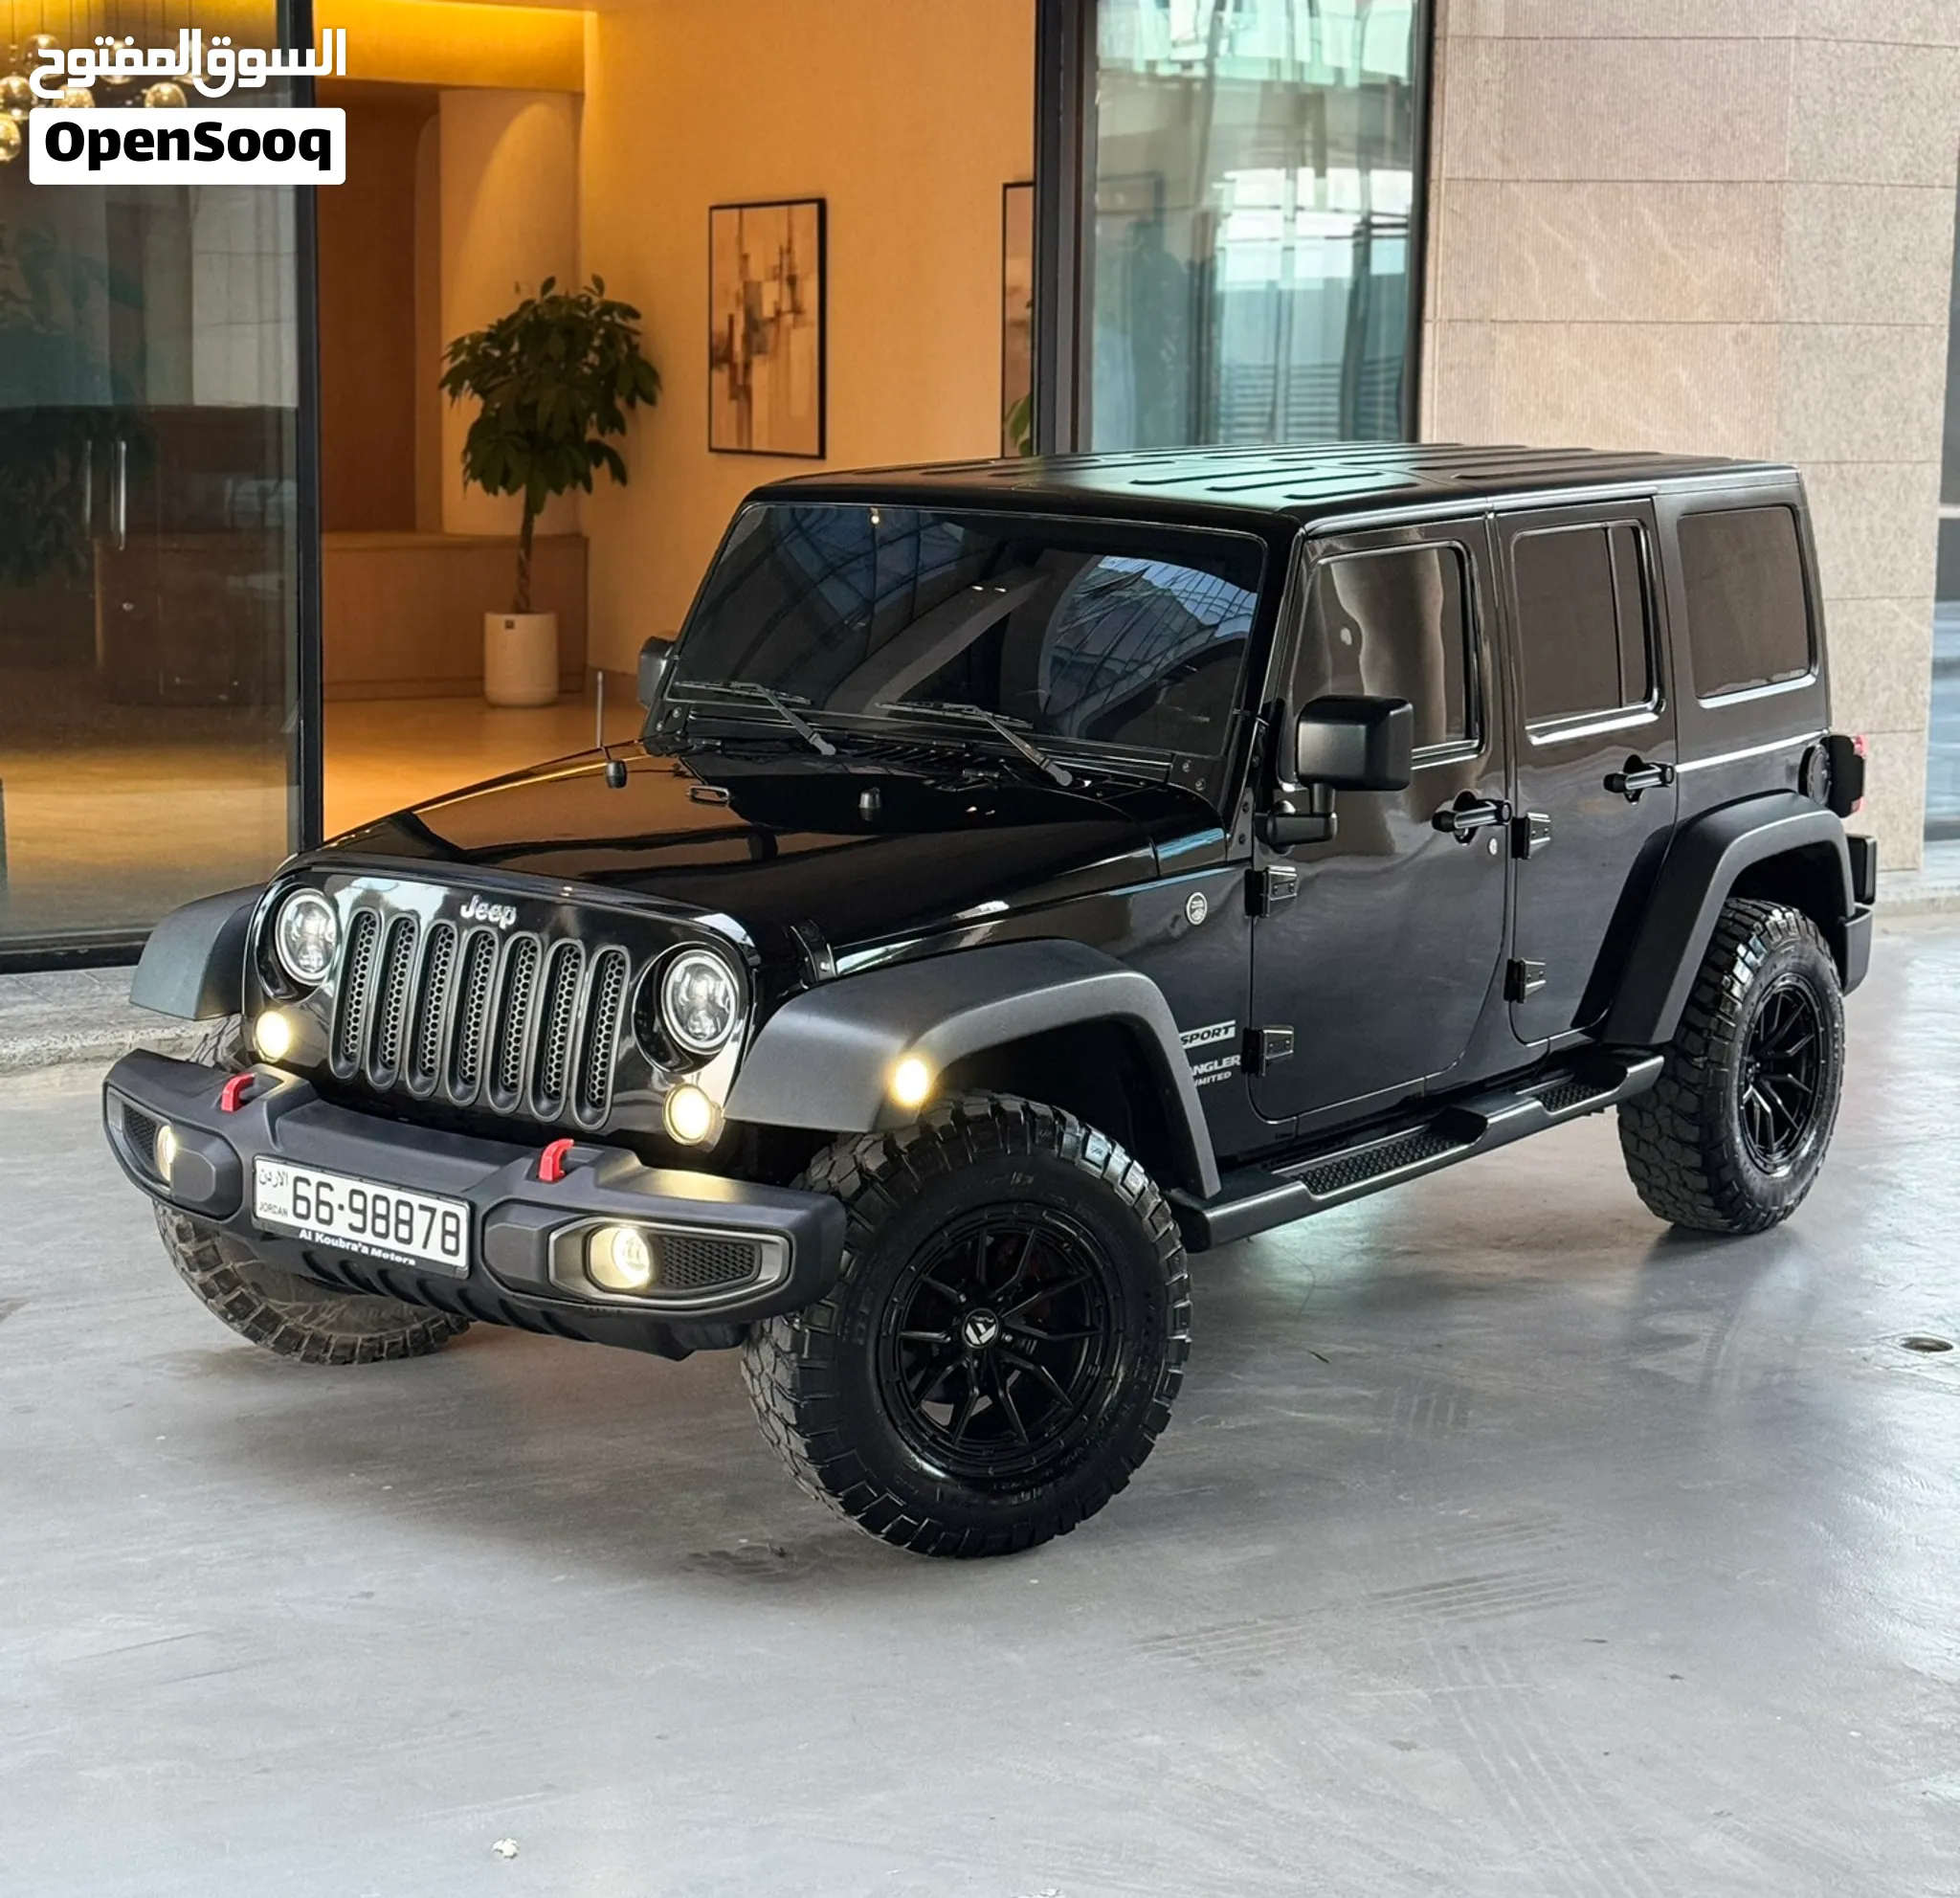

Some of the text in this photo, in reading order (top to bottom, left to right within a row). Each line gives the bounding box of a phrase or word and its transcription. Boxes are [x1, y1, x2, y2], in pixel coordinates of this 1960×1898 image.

[460, 894, 517, 929] Jeep
[1180, 1025, 1232, 1045] SPORT
[258, 1200, 288, 1217] JORDAN
[370, 1247, 416, 1266] Motors
